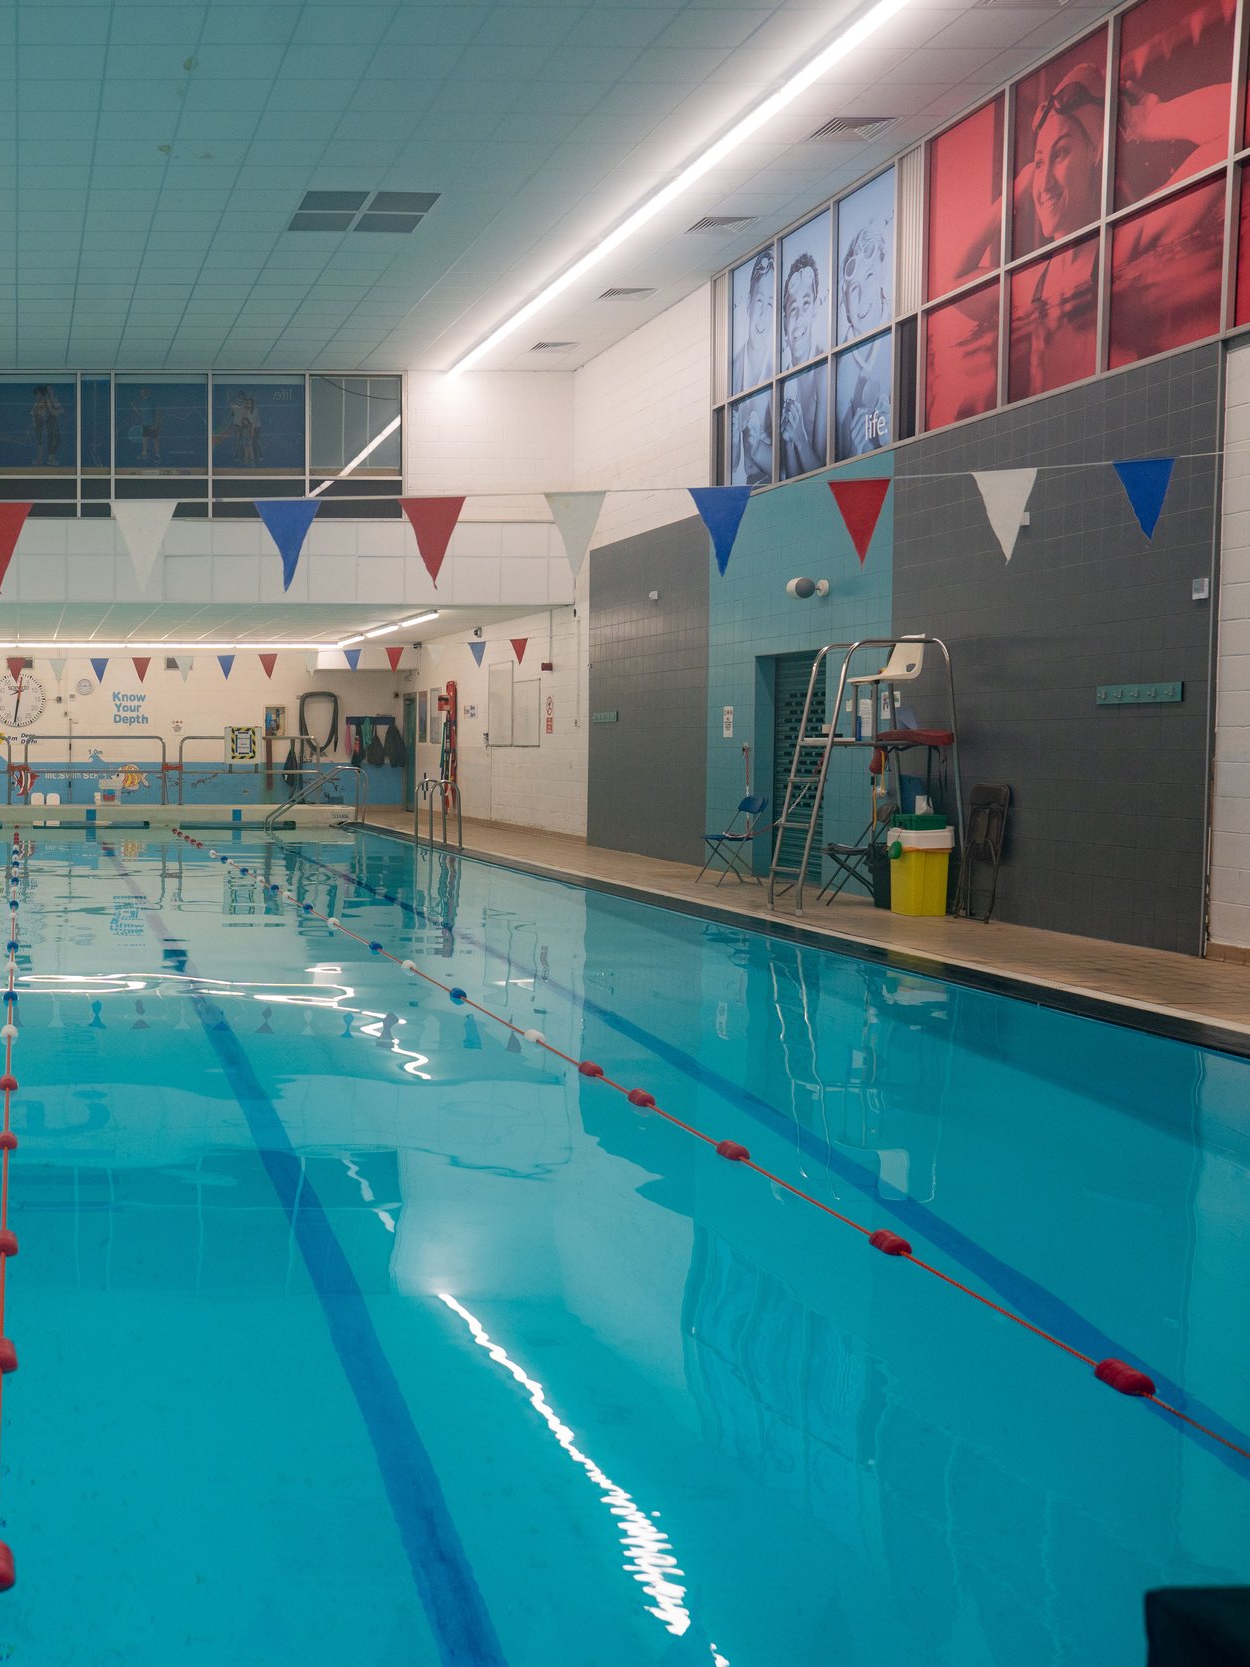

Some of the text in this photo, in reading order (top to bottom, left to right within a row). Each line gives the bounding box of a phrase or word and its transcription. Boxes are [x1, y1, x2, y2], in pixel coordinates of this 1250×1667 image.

[864, 409, 888, 440] life.
[112, 691, 146, 702] Know
[114, 703, 142, 713] Your
[113, 714, 149, 726] Depth
